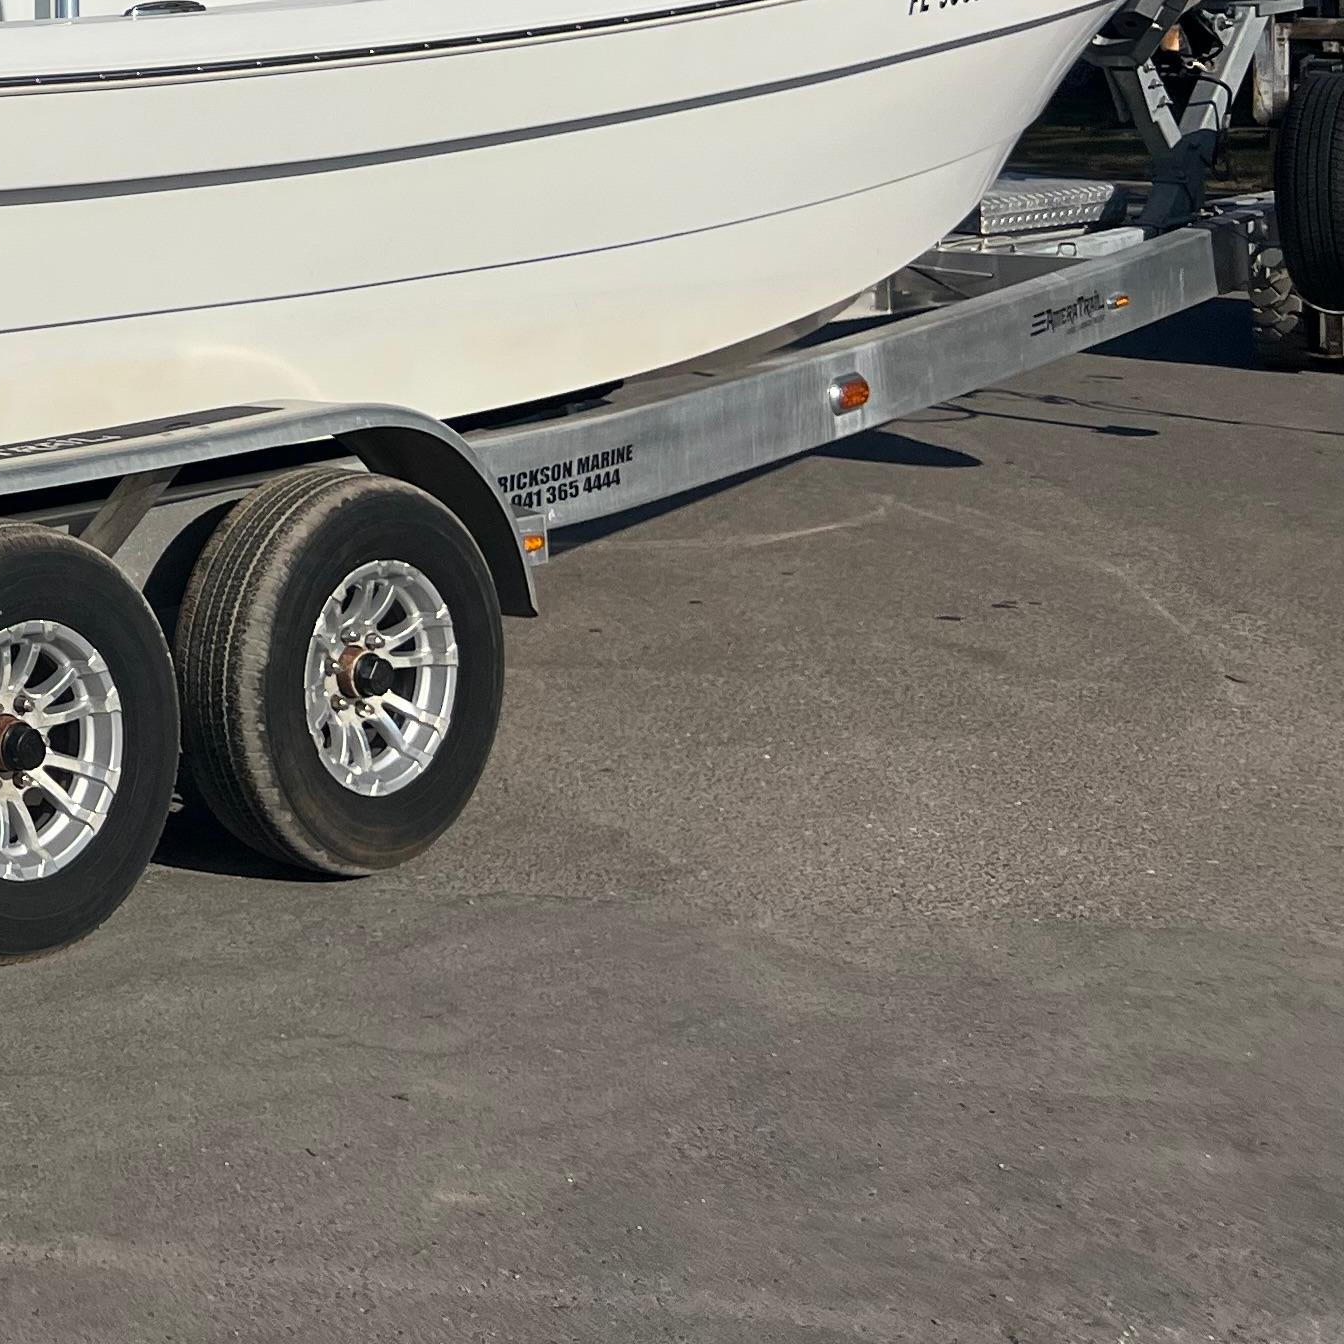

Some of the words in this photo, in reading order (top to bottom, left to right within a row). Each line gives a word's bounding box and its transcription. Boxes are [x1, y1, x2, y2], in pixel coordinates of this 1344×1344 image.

[497, 460, 573, 494] RICKSON
[577, 444, 634, 475] MARINE
[511, 488, 542, 508] 941
[546, 480, 579, 504] 365
[583, 468, 621, 493] 4444
